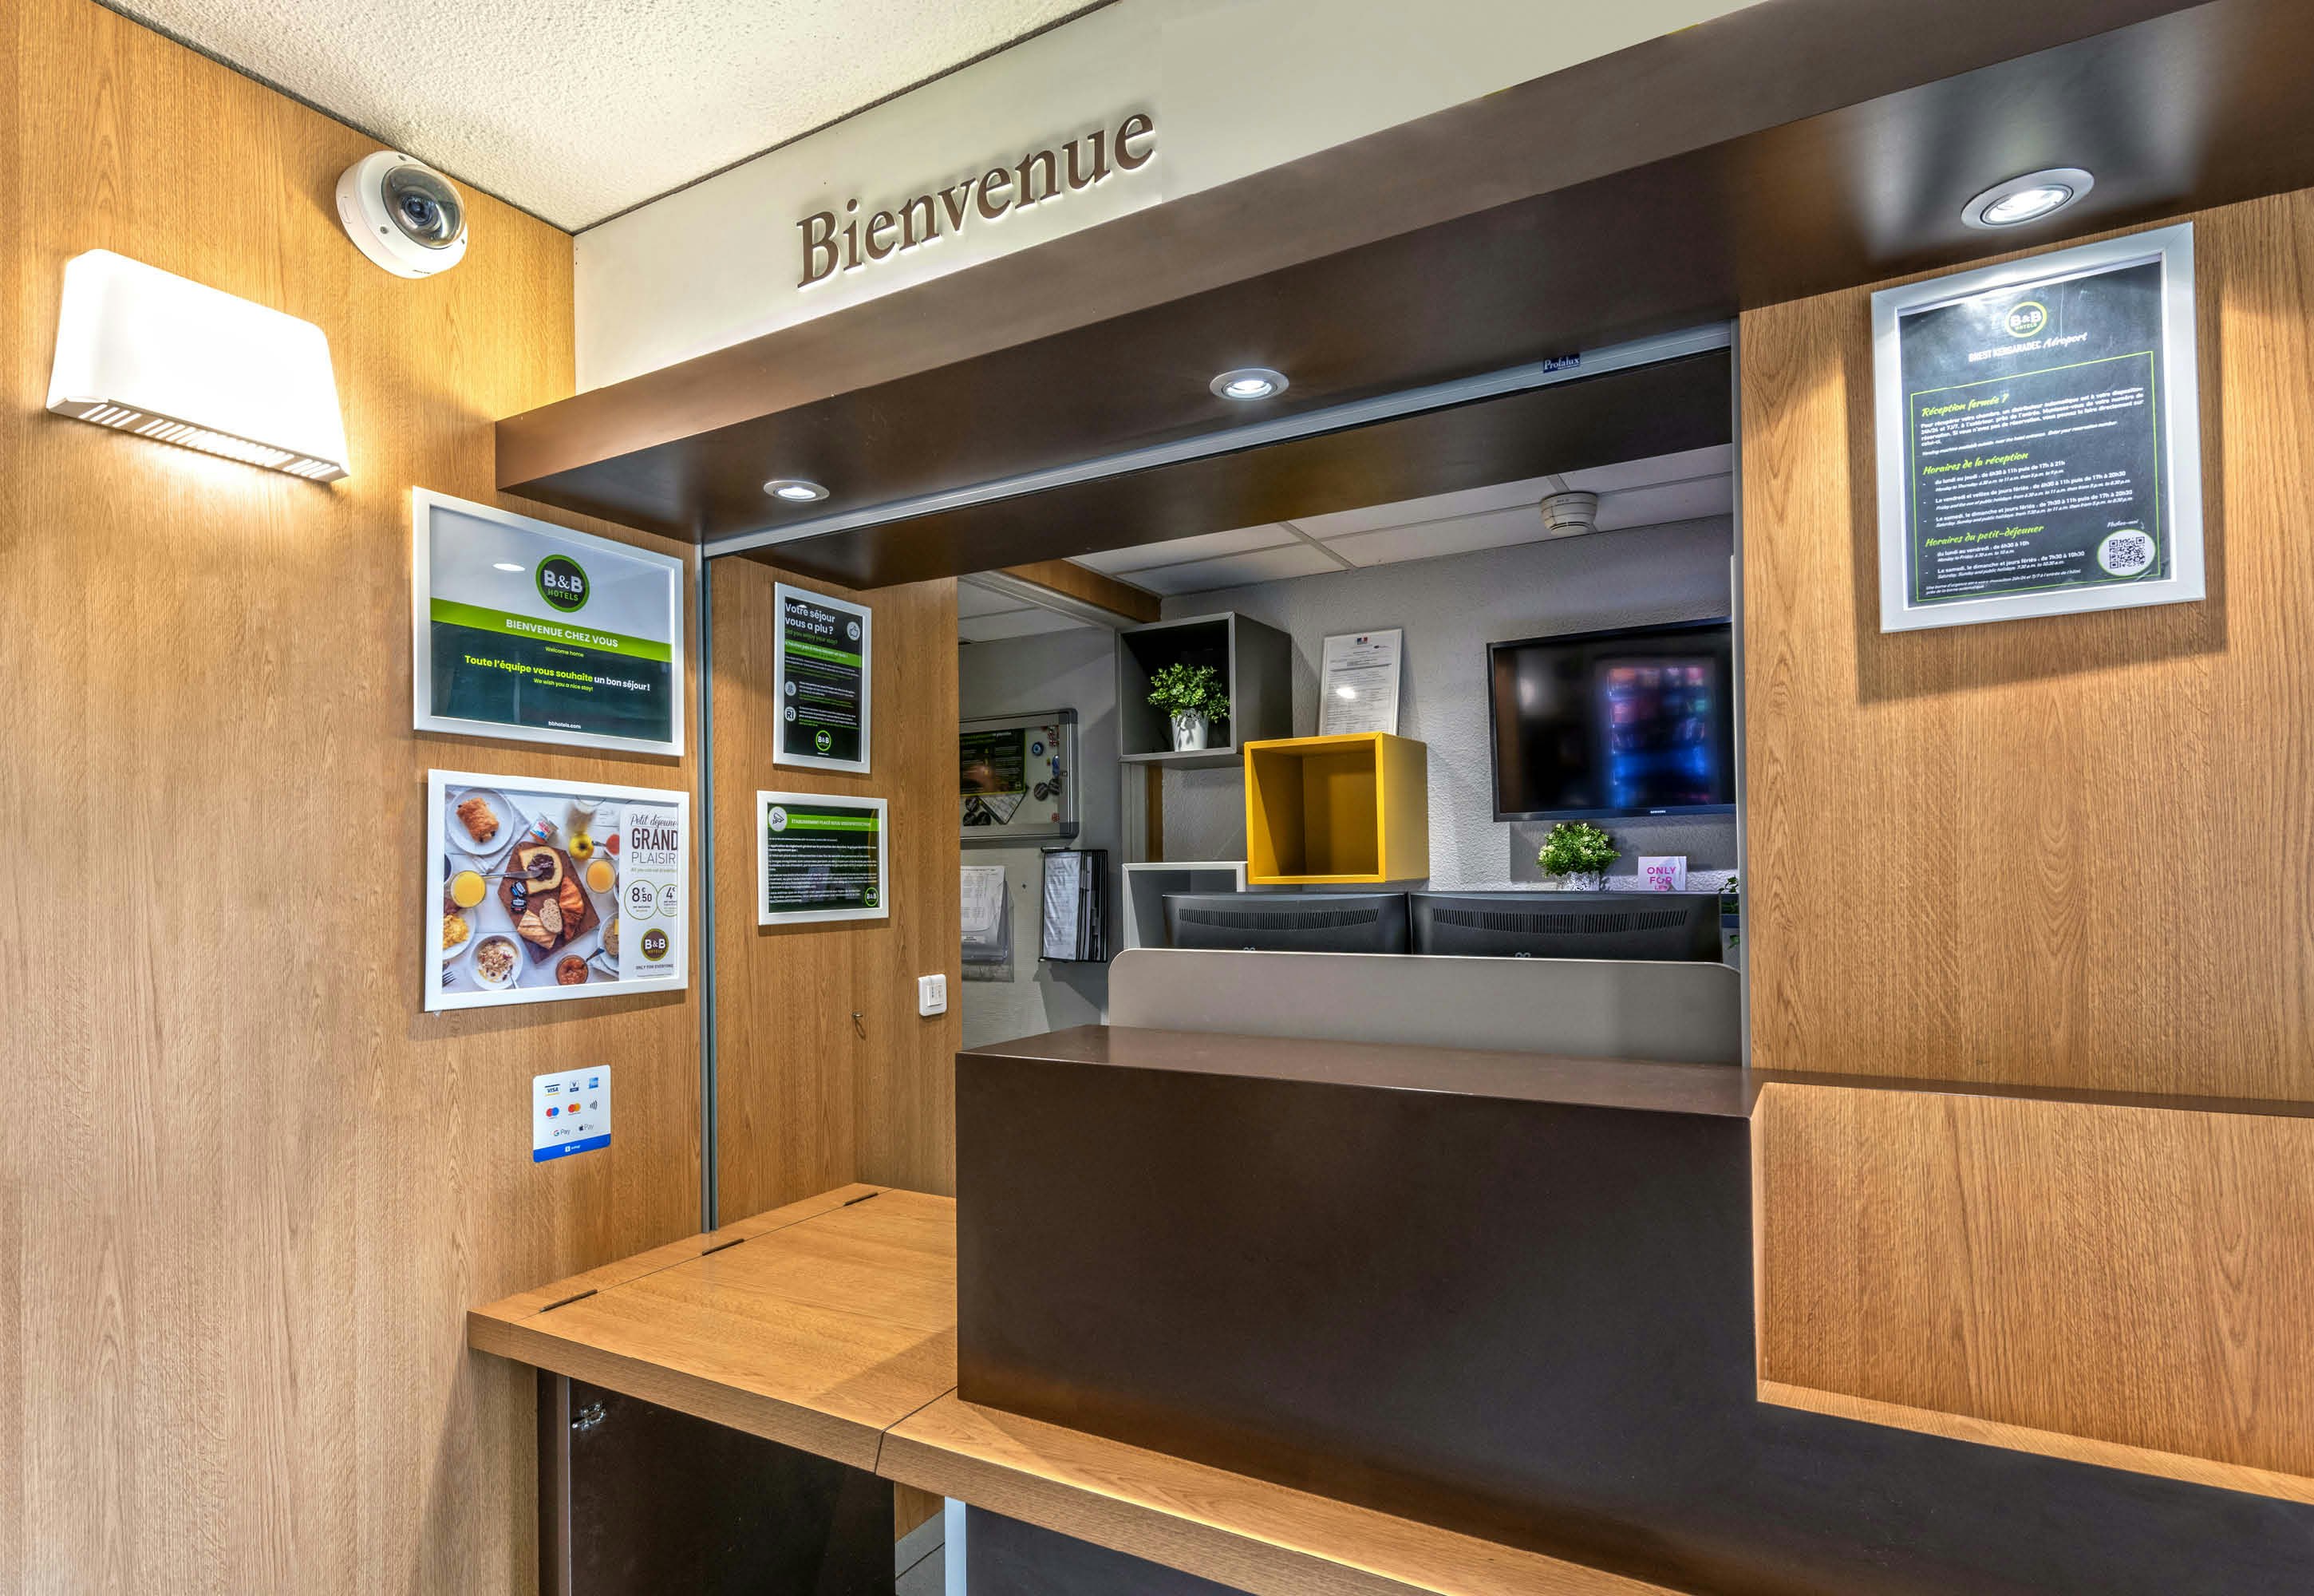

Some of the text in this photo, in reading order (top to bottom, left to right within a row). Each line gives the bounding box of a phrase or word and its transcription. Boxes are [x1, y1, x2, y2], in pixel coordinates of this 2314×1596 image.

[796, 113, 1154, 289] Bienvenue
[2009, 310, 2042, 328] B&B
[1921, 403, 1966, 417] Réception
[1922, 452, 2028, 475] Horaires de la réception
[1925, 526, 2044, 547] Horaires du petit-déjeuner
[544, 570, 582, 592] B&B
[547, 588, 578, 601] HOTELS
[785, 602, 835, 622] Votre séjour
[506, 619, 618, 647] BIENVENUE CHEZ VOUS
[785, 617, 806, 629] vous
[815, 623, 827, 634] plu
[830, 626, 834, 635] ?
[545, 646, 569, 655] Welcome
[464, 655, 492, 667] Toute
[494, 659, 531, 674] l'équipe
[533, 667, 554, 677] vous
[556, 670, 593, 682] souhaite
[606, 677, 622, 687] bon
[548, 721, 582, 729] bbhotels.com
[630, 813, 677, 829] Petit déjeune
[631, 828, 677, 851] GRAND
[631, 851, 676, 864] PLAISIR
[645, 938, 665, 950] B&B
